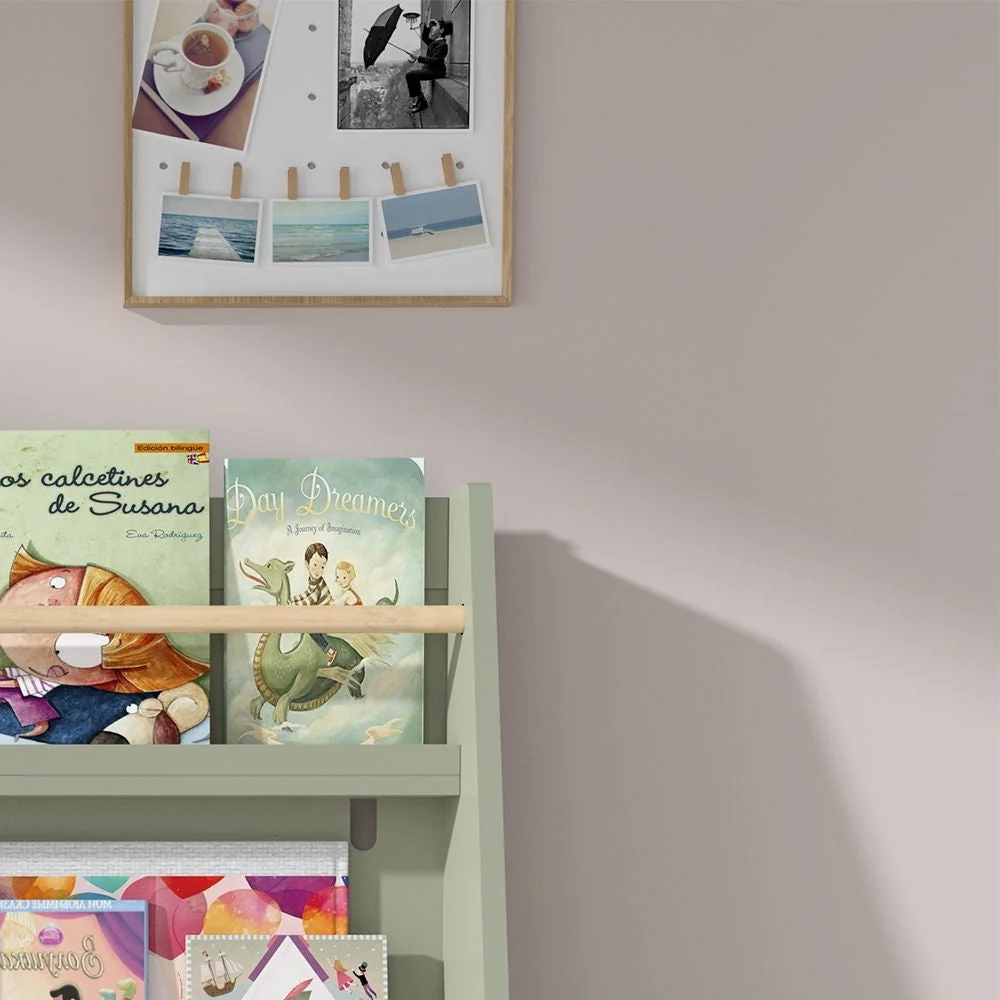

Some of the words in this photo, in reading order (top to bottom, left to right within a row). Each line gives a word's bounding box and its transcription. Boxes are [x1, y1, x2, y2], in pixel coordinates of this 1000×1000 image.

[41, 465, 169, 488] calcetines
[48, 494, 79, 514] de
[89, 491, 205, 516] Susana
[226, 477, 285, 530] Day
[296, 467, 417, 529] Dreamers
